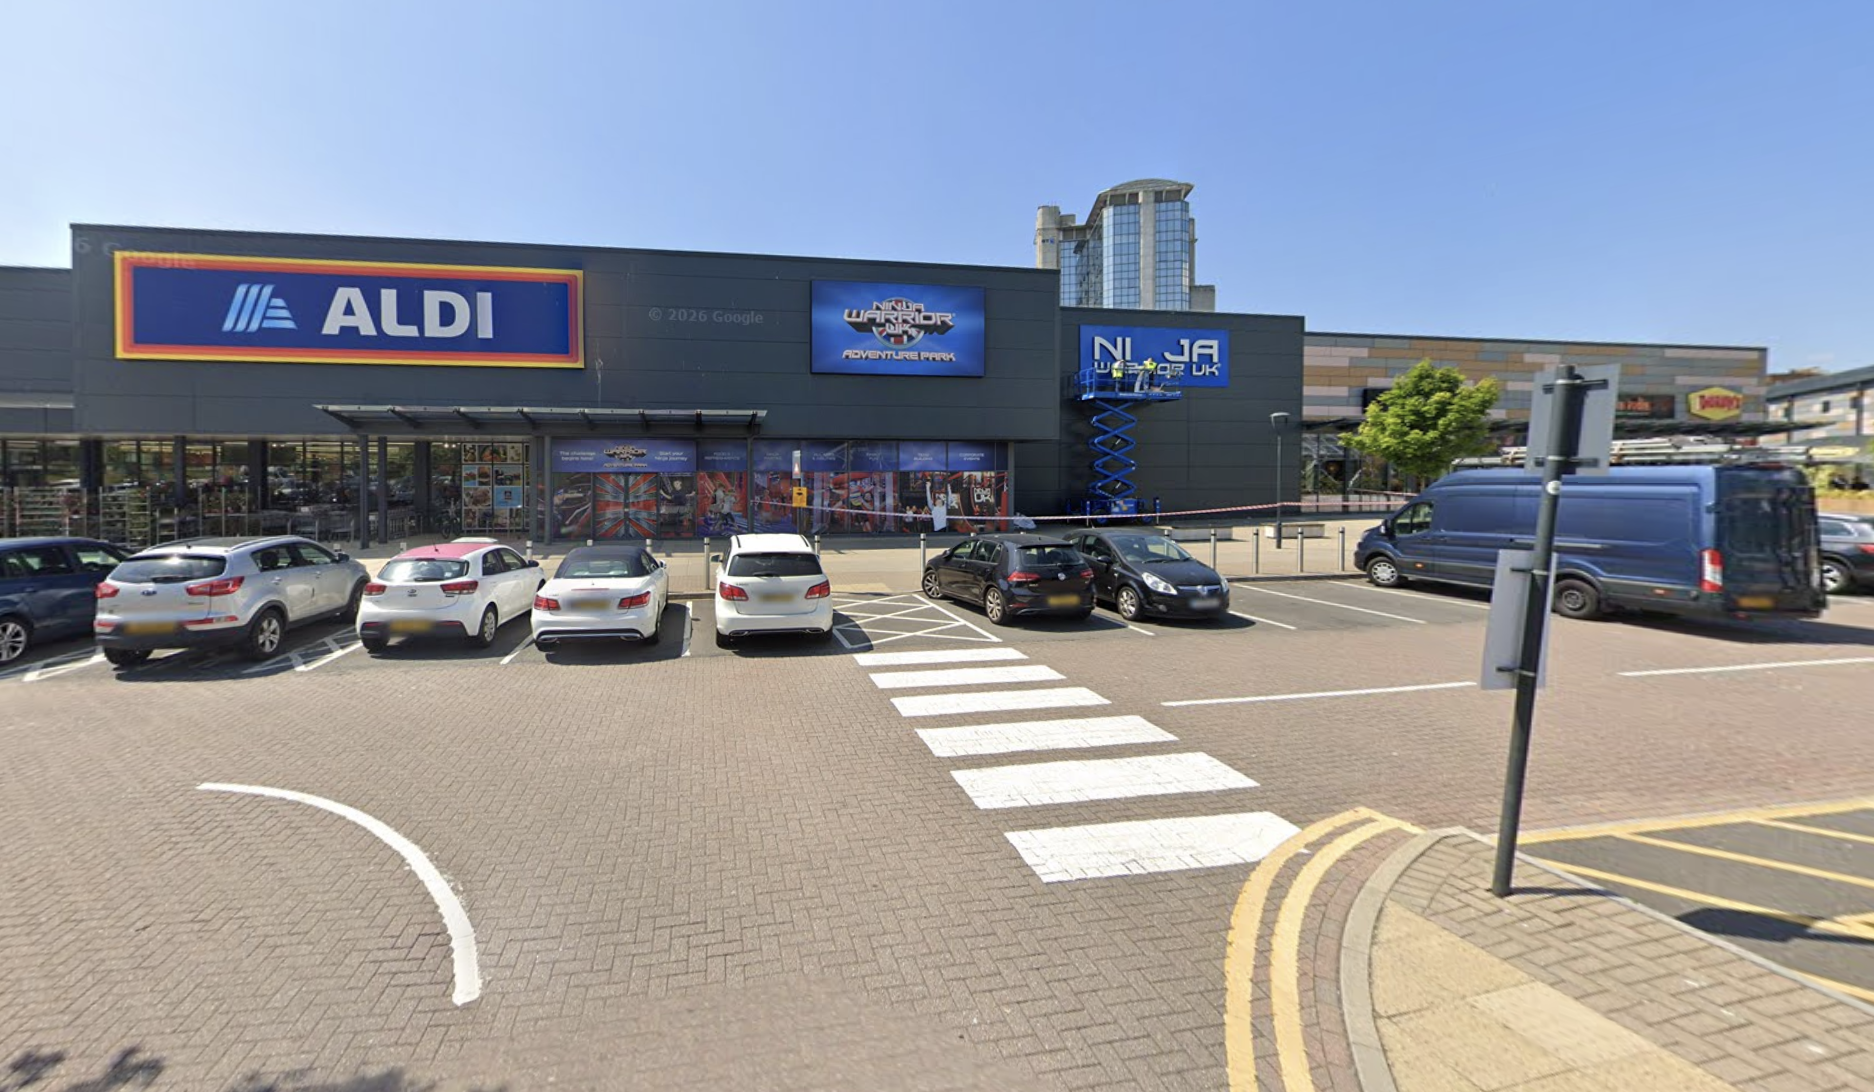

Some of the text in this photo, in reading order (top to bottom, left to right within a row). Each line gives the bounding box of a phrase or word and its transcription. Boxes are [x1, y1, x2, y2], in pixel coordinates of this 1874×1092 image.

[321, 287, 493, 339] ALDI
[872, 301, 925, 312] NINJA
[843, 308, 955, 327] WARRIOR
[885, 322, 912, 335] UK
[842, 350, 956, 361] ADVENTURE PARK
[1192, 363, 1219, 376] UK
